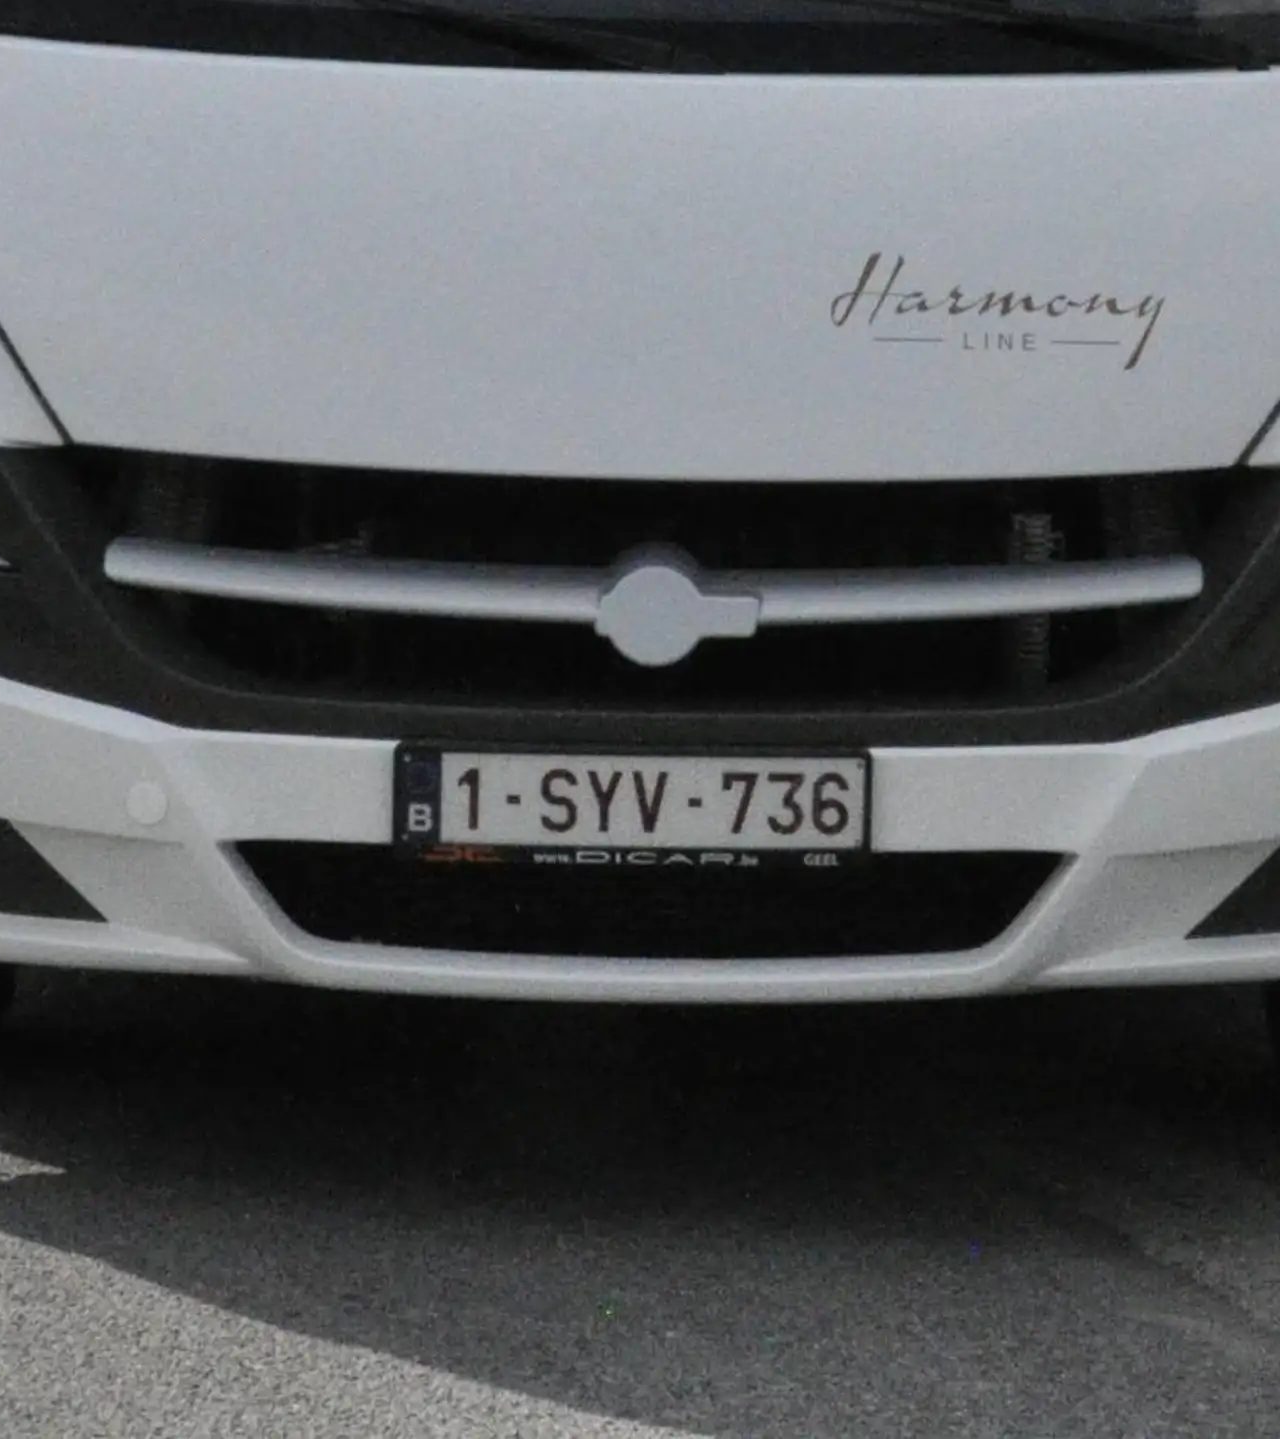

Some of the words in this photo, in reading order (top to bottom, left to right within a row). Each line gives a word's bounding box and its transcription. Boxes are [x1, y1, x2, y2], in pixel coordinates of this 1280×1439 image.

[830, 252, 1165, 370] Harmony
[963, 332, 1038, 351] LINE
[408, 803, 433, 832] B
[457, 767, 850, 836] 1-SYV-736
